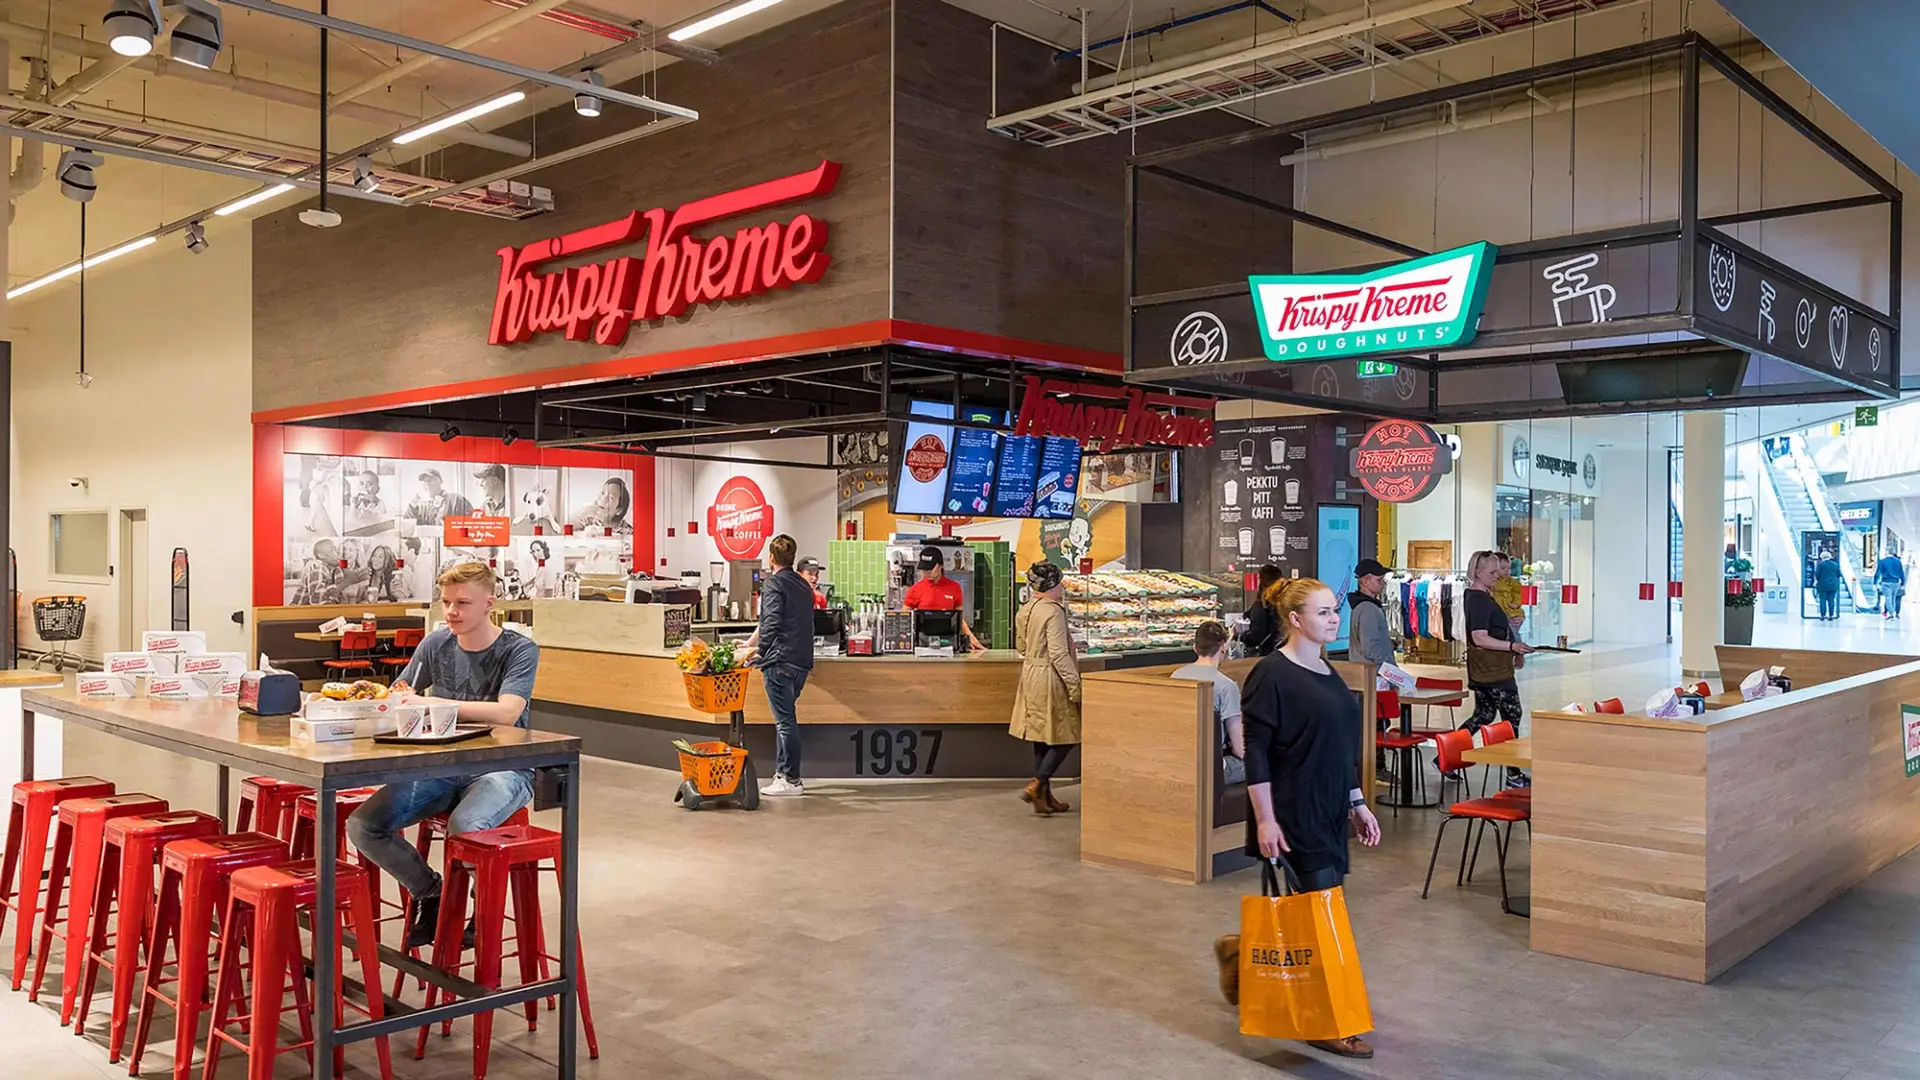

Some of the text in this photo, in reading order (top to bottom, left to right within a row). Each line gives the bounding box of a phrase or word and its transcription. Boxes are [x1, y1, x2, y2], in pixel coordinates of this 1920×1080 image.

[487, 160, 843, 346] Krispy Kreme
[1278, 276, 1452, 331] Krispy Kreme
[1279, 327, 1445, 355] DOUGHNUTS
[1015, 375, 1129, 454] Krispy
[1122, 388, 1218, 448] Kreme
[1376, 424, 1412, 442] HOT
[1356, 446, 1436, 469] Krispy Kreme
[1375, 478, 1415, 498] NOW
[1251, 506, 1274, 519] KAFFI
[734, 531, 762, 539] COFFEE
[850, 729, 943, 775] 1937
